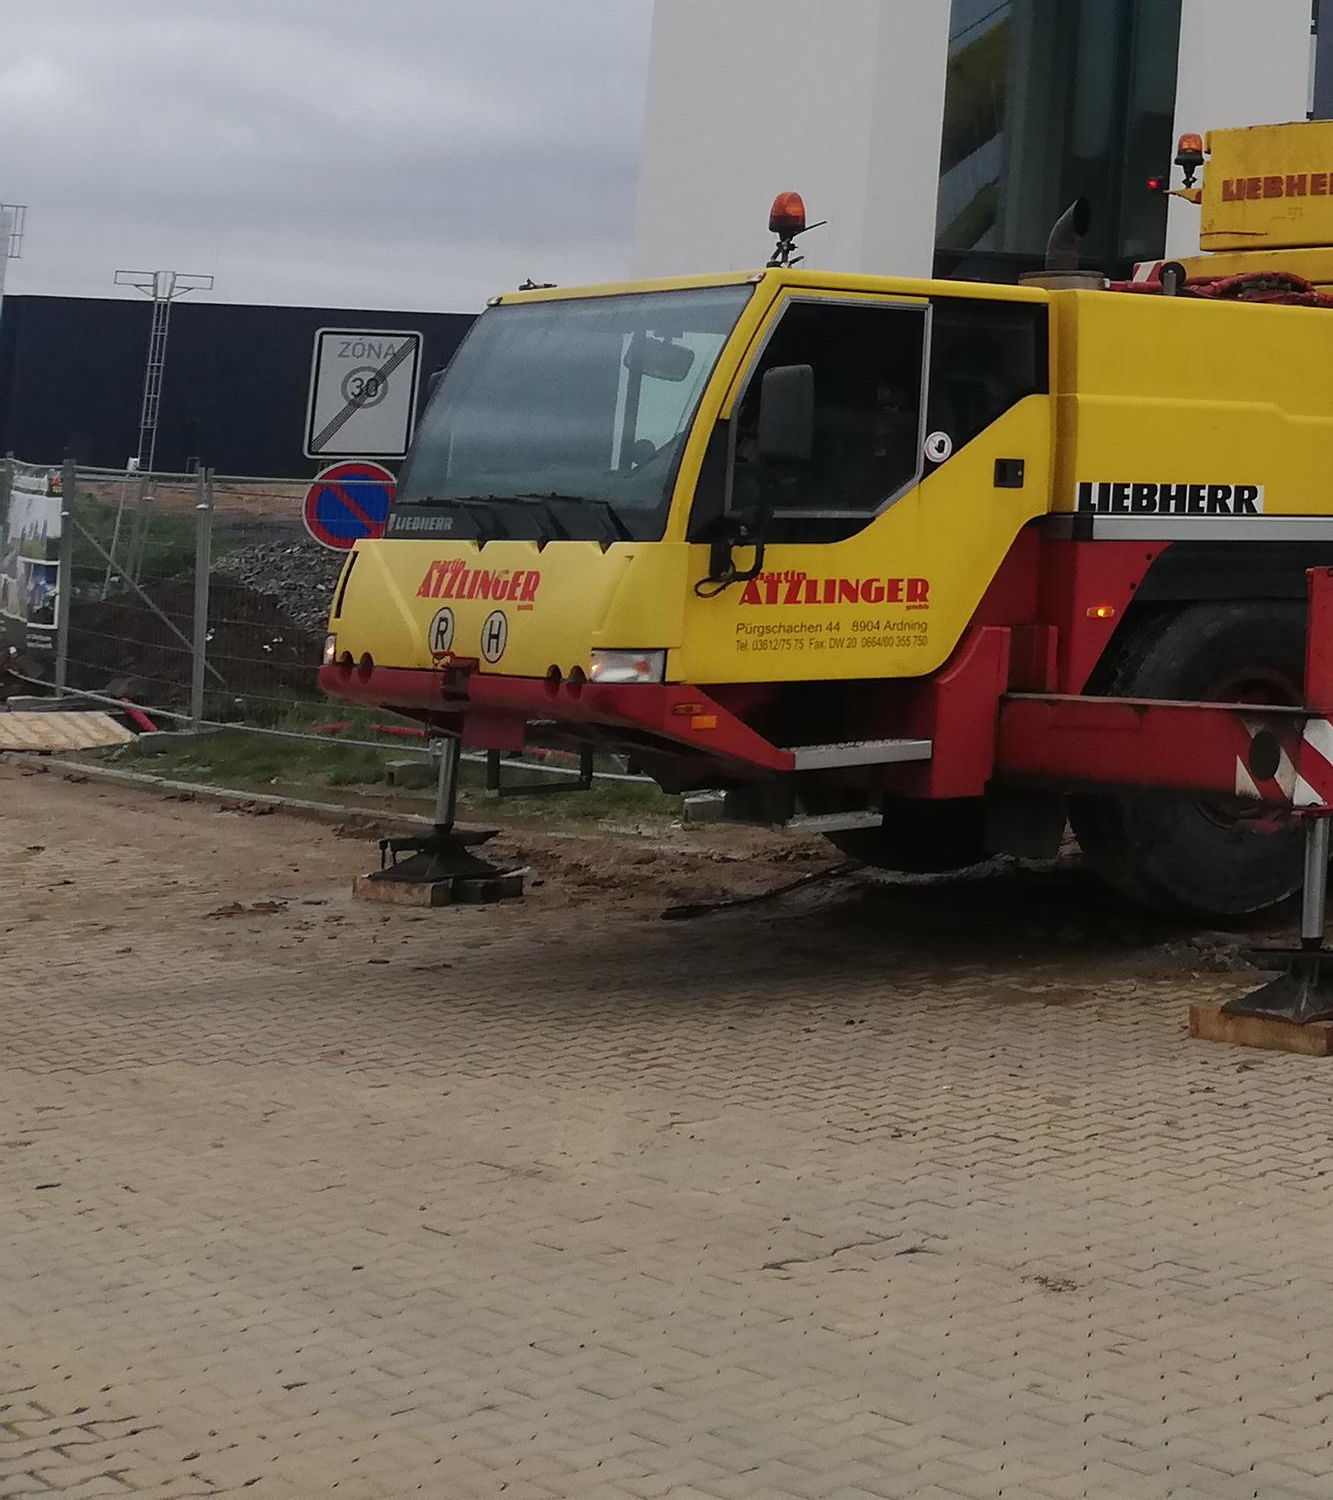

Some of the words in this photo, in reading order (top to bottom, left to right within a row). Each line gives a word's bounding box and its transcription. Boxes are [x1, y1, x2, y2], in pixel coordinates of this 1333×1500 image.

[337, 338, 397, 359] ZÓNA
[351, 377, 378, 398] 30
[1078, 482, 1258, 513] LIEBHERR
[416, 564, 541, 602] ATZLINGER
[738, 577, 930, 605] ATZLINGER
[435, 617, 448, 650] R
[487, 619, 503, 653] H
[736, 621, 822, 637] Pürgschachen
[825, 621, 840, 632] 44
[852, 620, 880, 632] 8904
[883, 620, 928, 633] Ardning
[793, 638, 804, 650] 75
[829, 638, 844, 650] DW
[846, 637, 857, 649] 20
